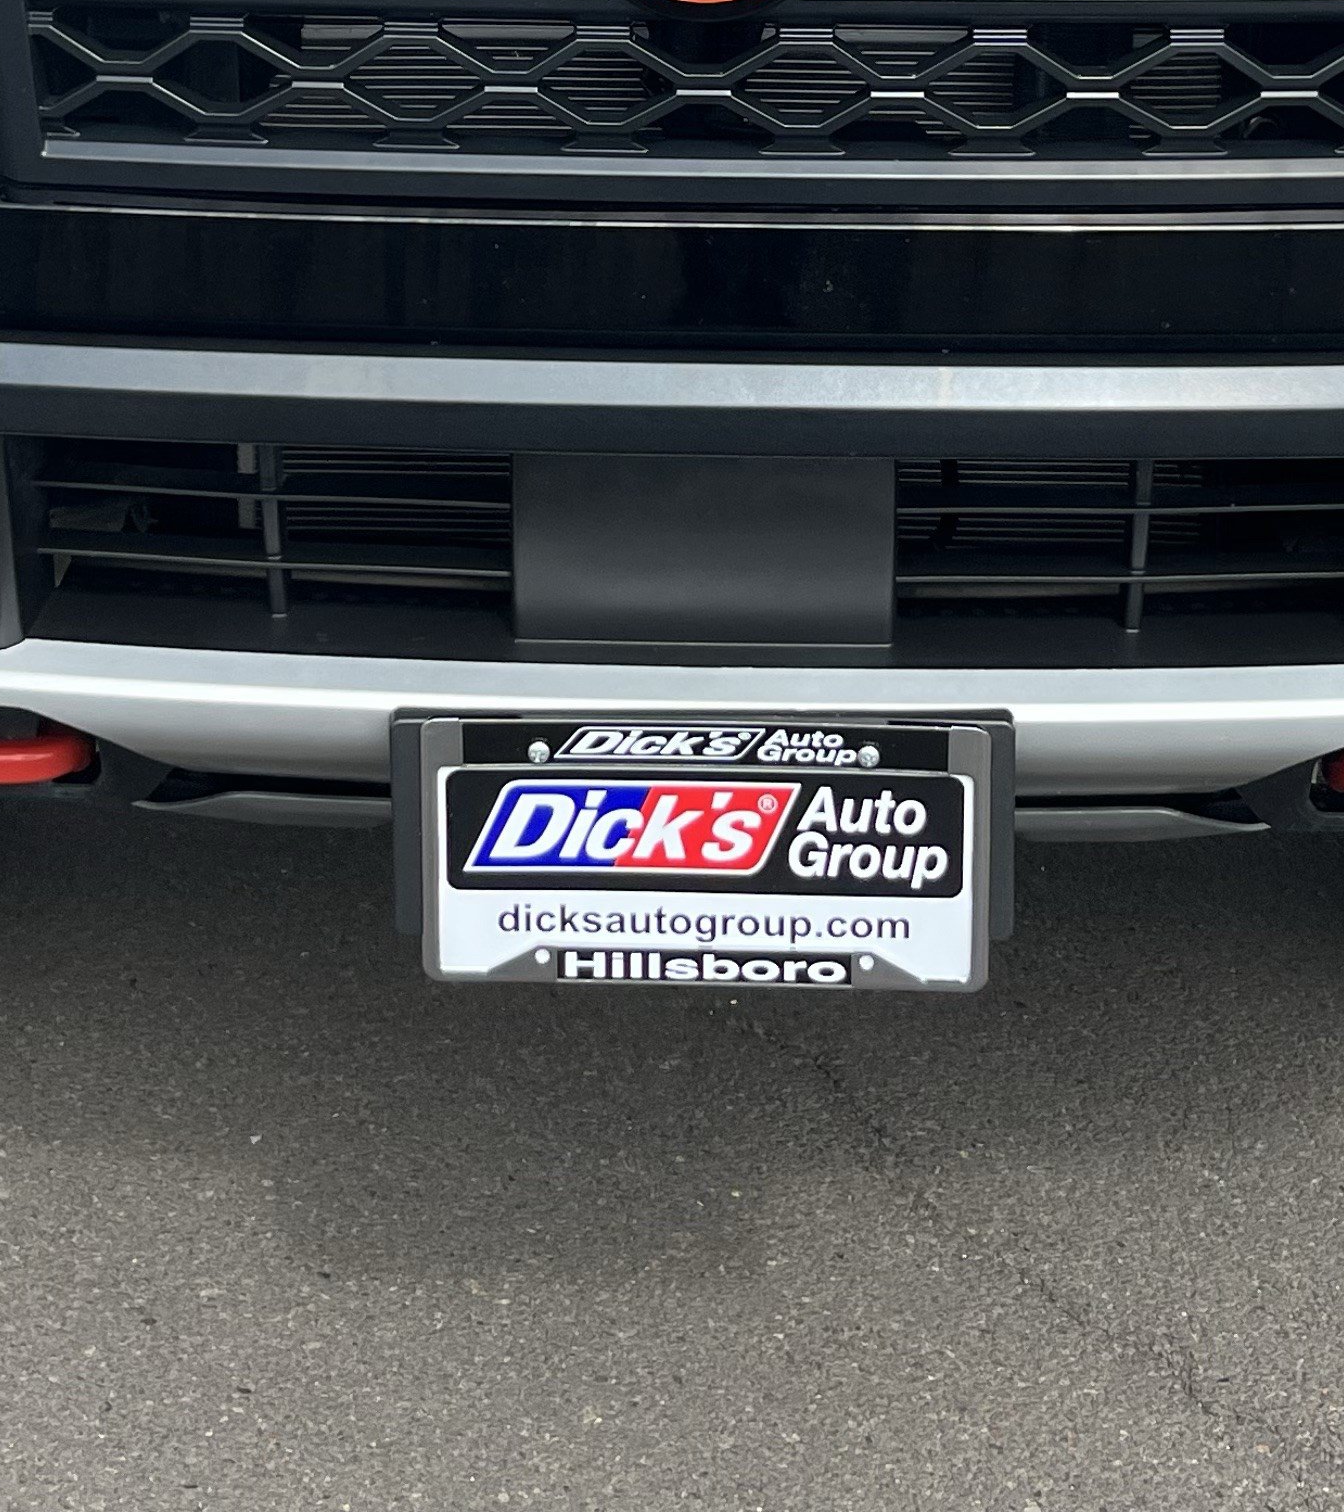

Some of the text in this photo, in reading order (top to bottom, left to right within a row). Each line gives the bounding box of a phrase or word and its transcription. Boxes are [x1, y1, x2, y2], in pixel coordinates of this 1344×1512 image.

[756, 744, 857, 766] Group
[763, 728, 843, 747] Auto
[796, 786, 926, 836] Auto
[788, 831, 948, 889] Group
[497, 903, 910, 944] dicksautogroup.com
[564, 952, 846, 983] Hillsboro
